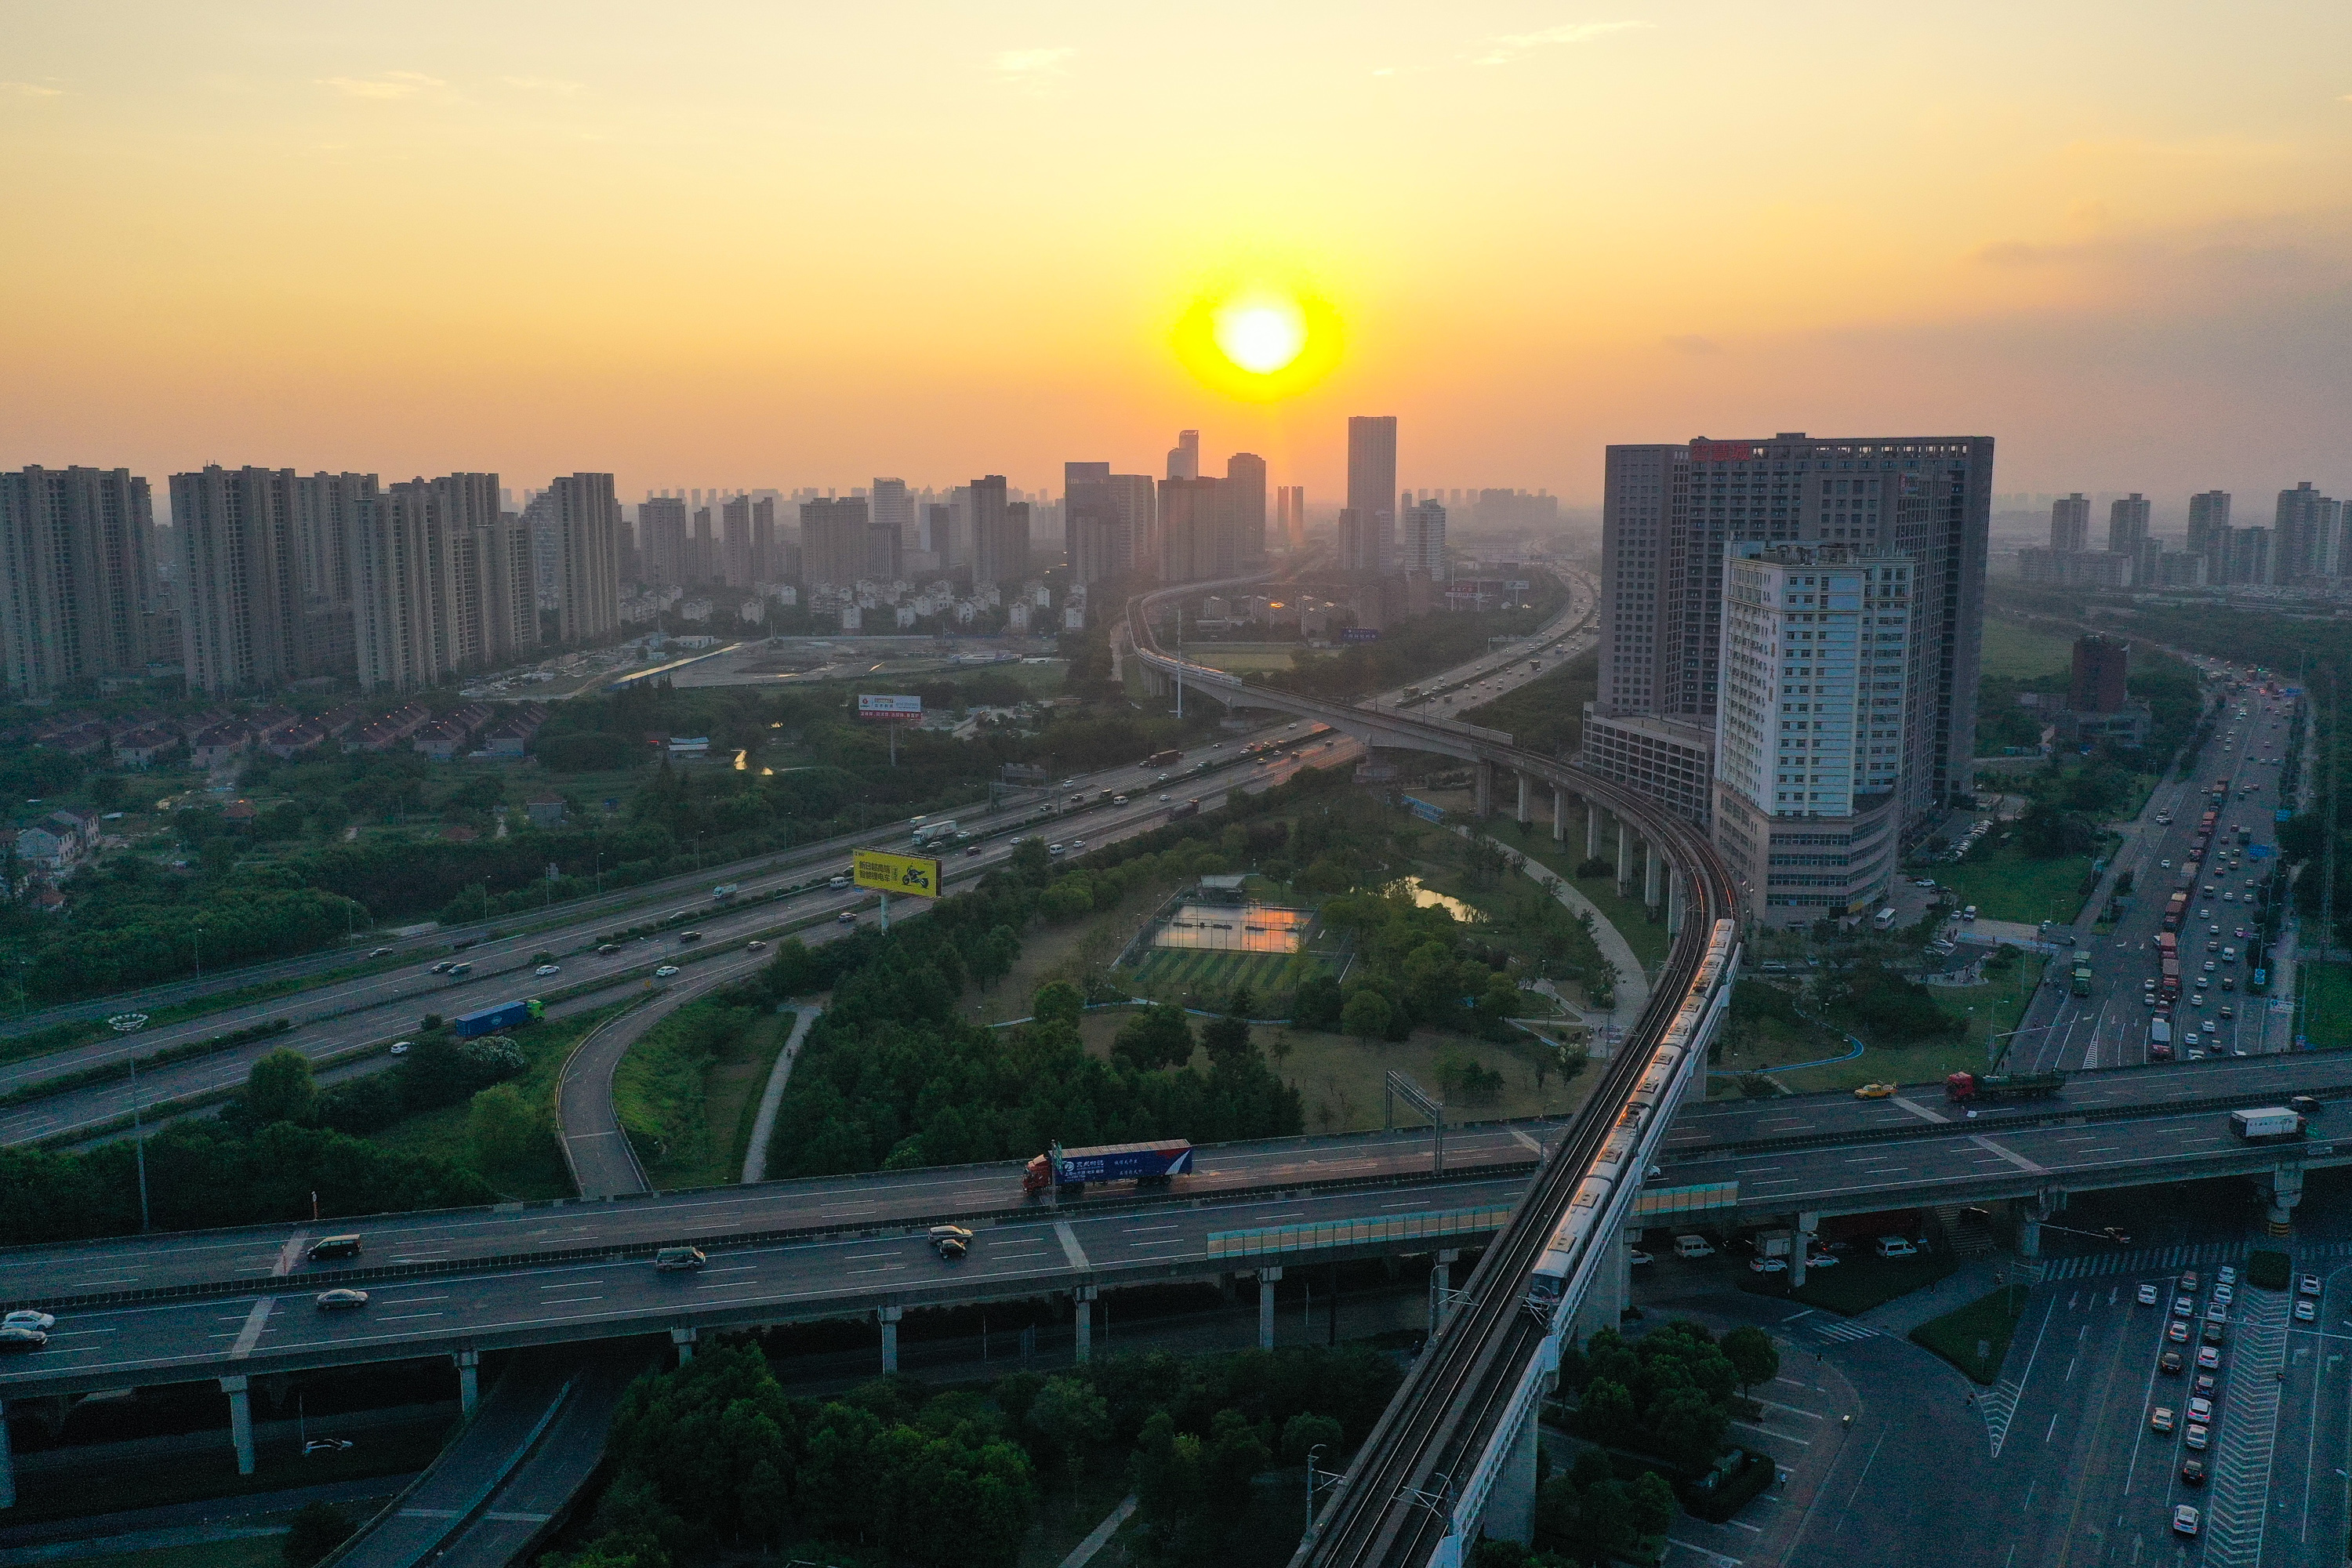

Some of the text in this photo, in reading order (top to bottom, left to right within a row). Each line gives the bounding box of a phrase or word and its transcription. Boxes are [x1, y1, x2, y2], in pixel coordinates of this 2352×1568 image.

[1692, 442, 1750, 461] 智慧城
[859, 861, 891, 873] 新日超高端
